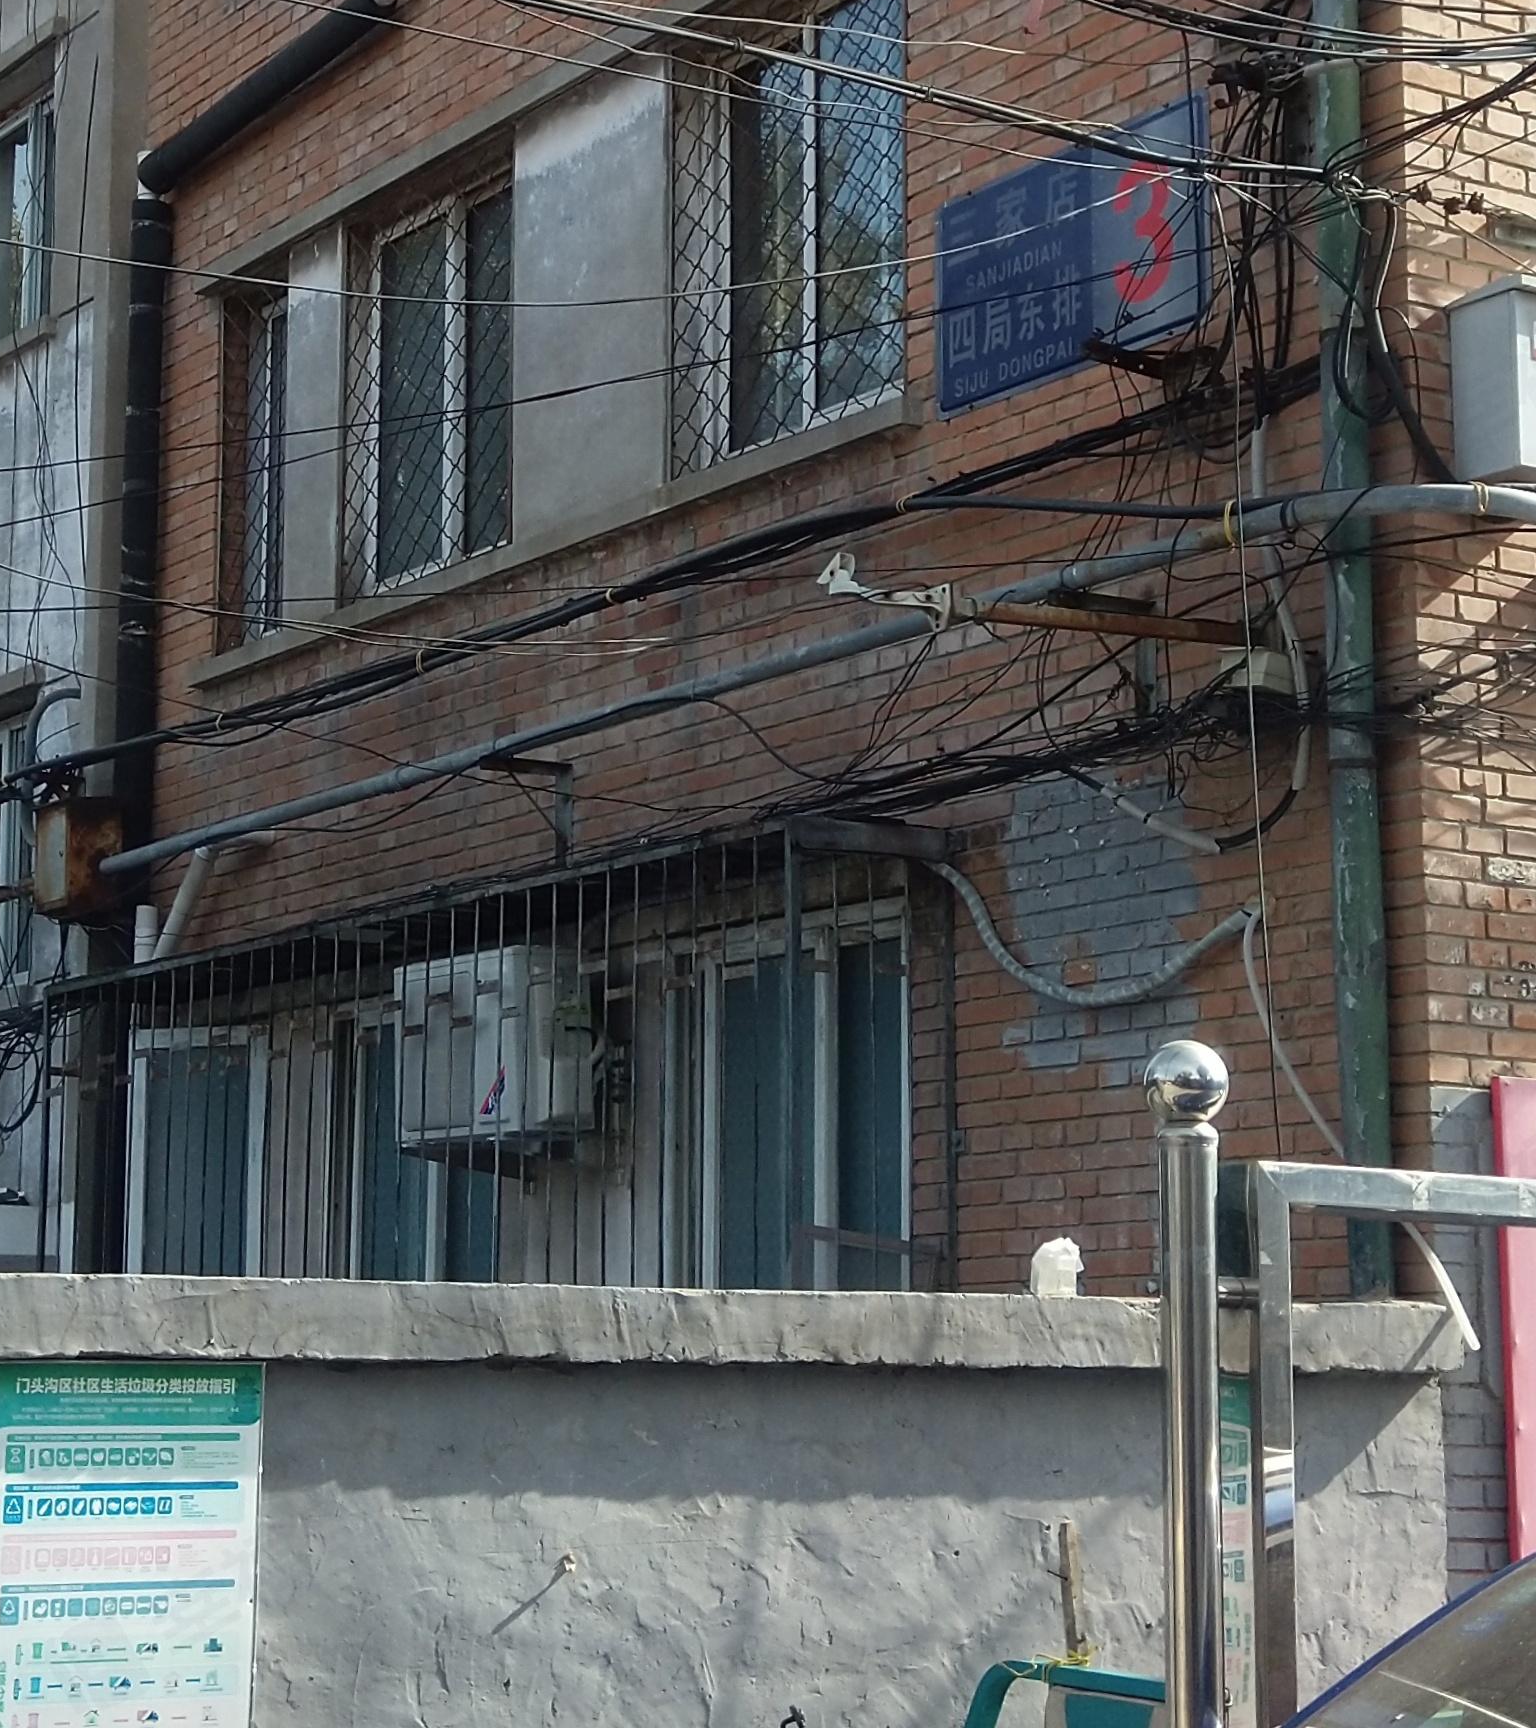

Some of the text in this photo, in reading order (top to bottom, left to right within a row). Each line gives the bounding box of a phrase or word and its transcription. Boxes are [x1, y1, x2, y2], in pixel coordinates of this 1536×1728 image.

[946, 168, 1078, 268] 三家店
[1112, 156, 1175, 304] 3
[966, 239, 1064, 291] SANJIADIAN
[948, 263, 1083, 368] 四局东排
[954, 335, 1074, 399] SIJU DONGPAI
[15, 1376, 236, 1396] 门头沟区社区生活垃圾分类投放指引
